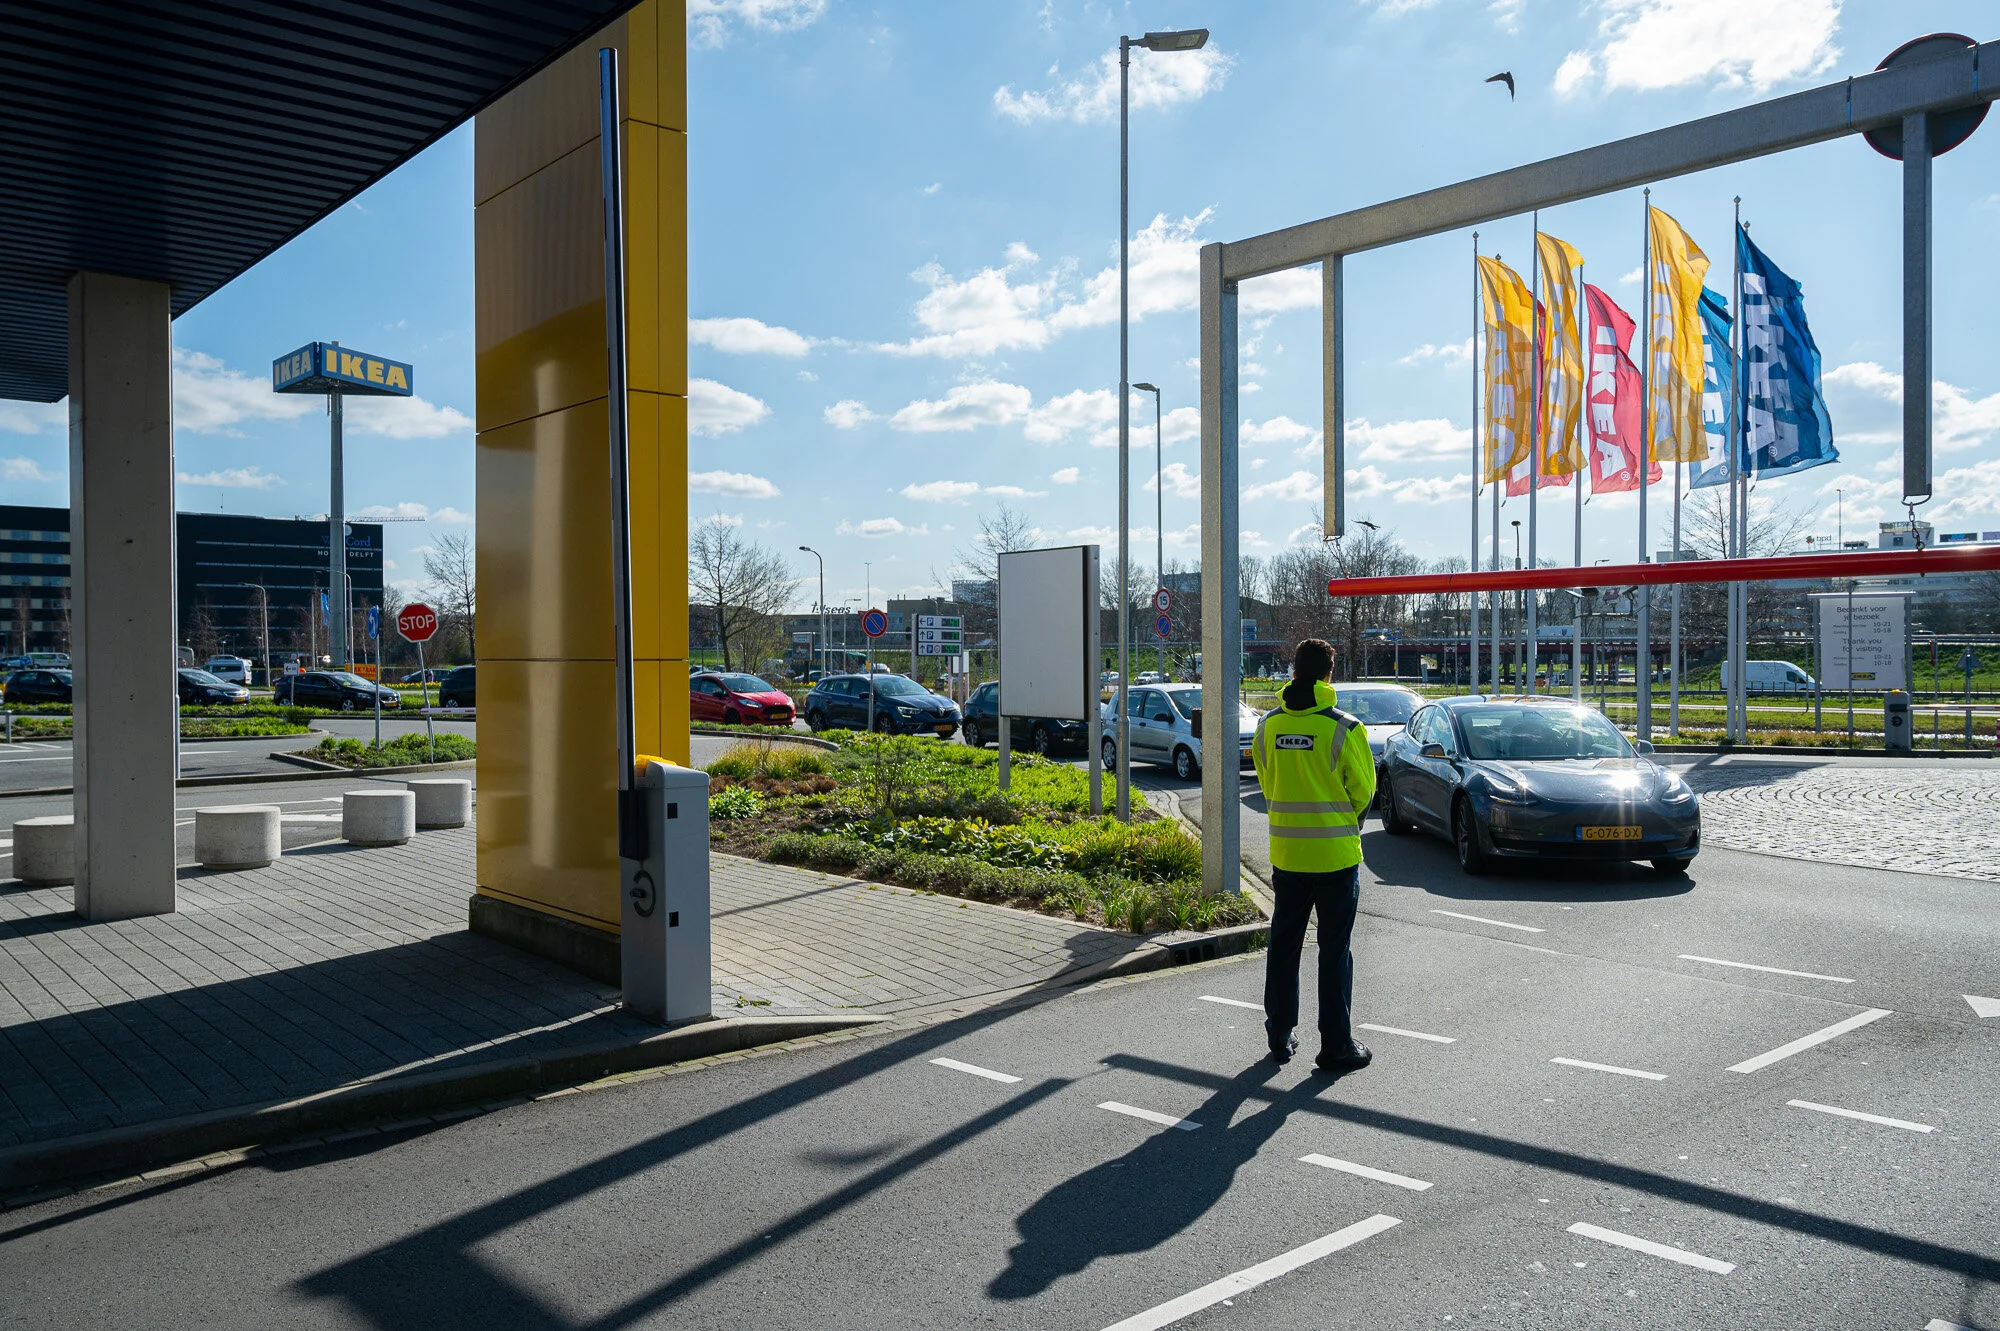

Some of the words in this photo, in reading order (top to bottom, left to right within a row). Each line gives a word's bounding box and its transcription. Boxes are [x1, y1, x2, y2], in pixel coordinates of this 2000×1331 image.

[274, 350, 311, 387] IKEA
[326, 349, 408, 390] IKEA
[1744, 272, 1776, 456] IKEA
[1591, 325, 1627, 480] IKEA
[321, 535, 371, 546] WCord
[811, 600, 851, 614] Alseas
[1160, 596, 1167, 605] 15
[400, 614, 435, 631] STOP
[1280, 738, 1309, 746] IKEA
[1585, 828, 1639, 838] G-076-DX
